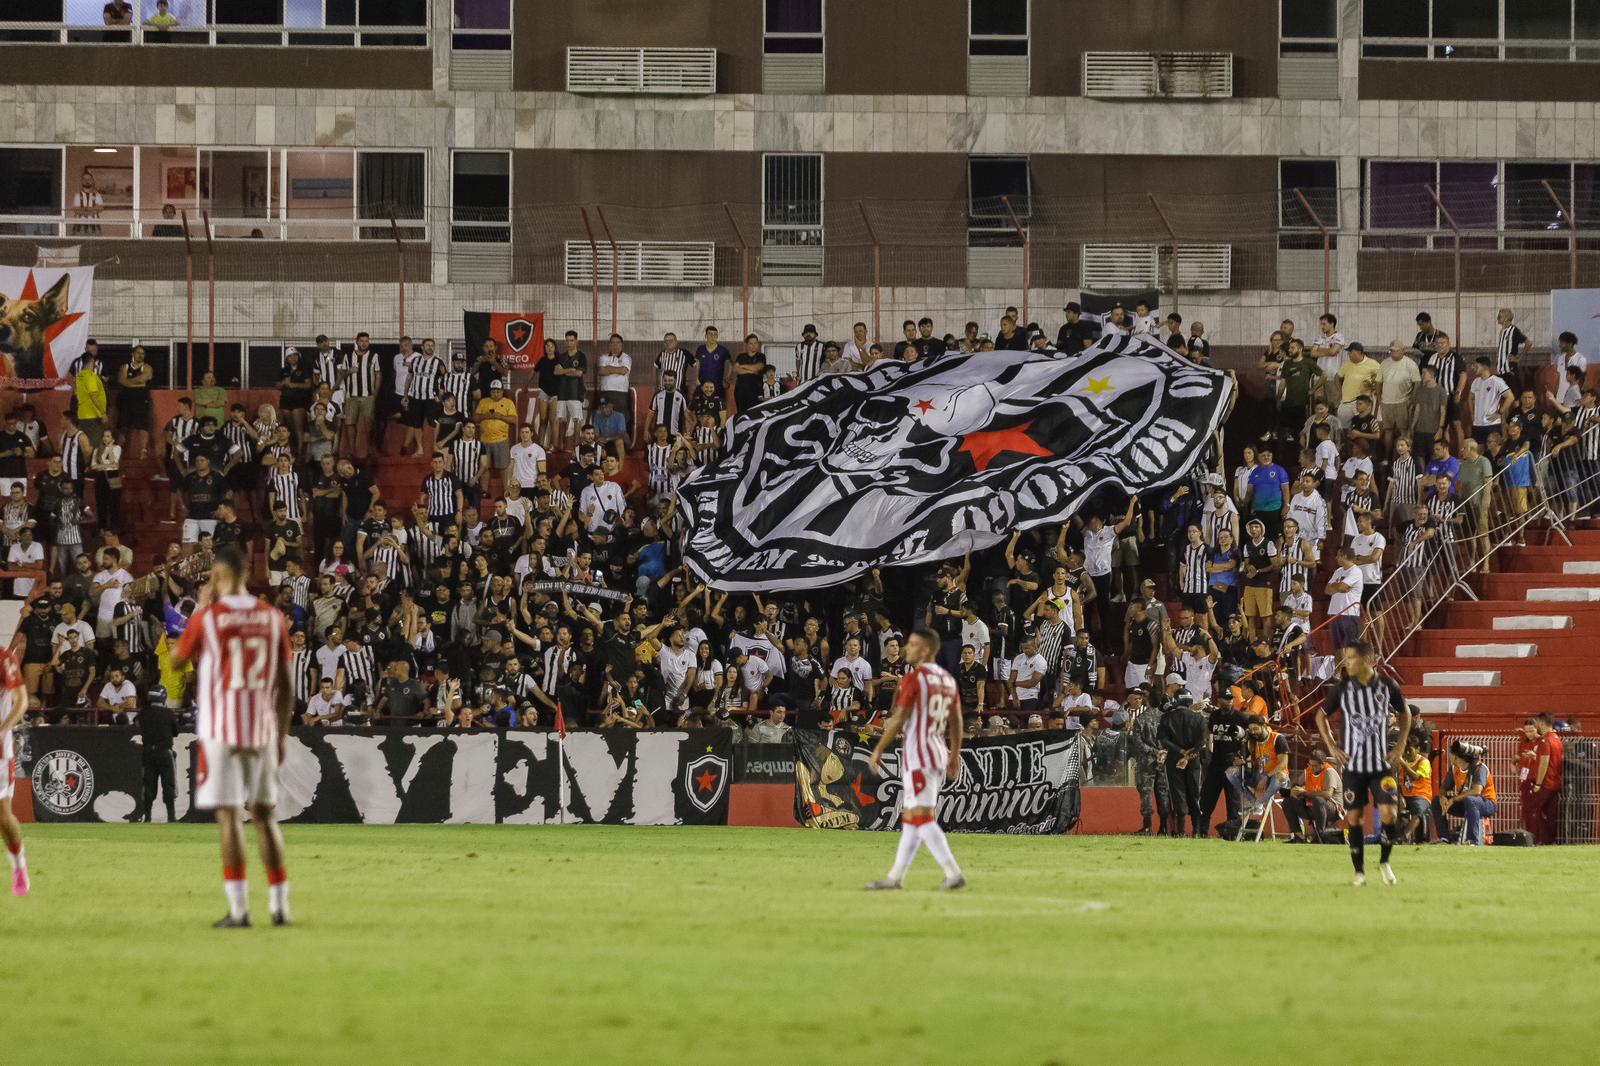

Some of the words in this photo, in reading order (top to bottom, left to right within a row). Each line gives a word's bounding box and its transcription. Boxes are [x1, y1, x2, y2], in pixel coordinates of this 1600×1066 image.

[228, 636, 267, 689] 12
[93, 731, 690, 825] JVEM
[745, 760, 795, 777] ambev
[819, 813, 851, 829] OVEM
[870, 777, 1058, 830] Fminino
